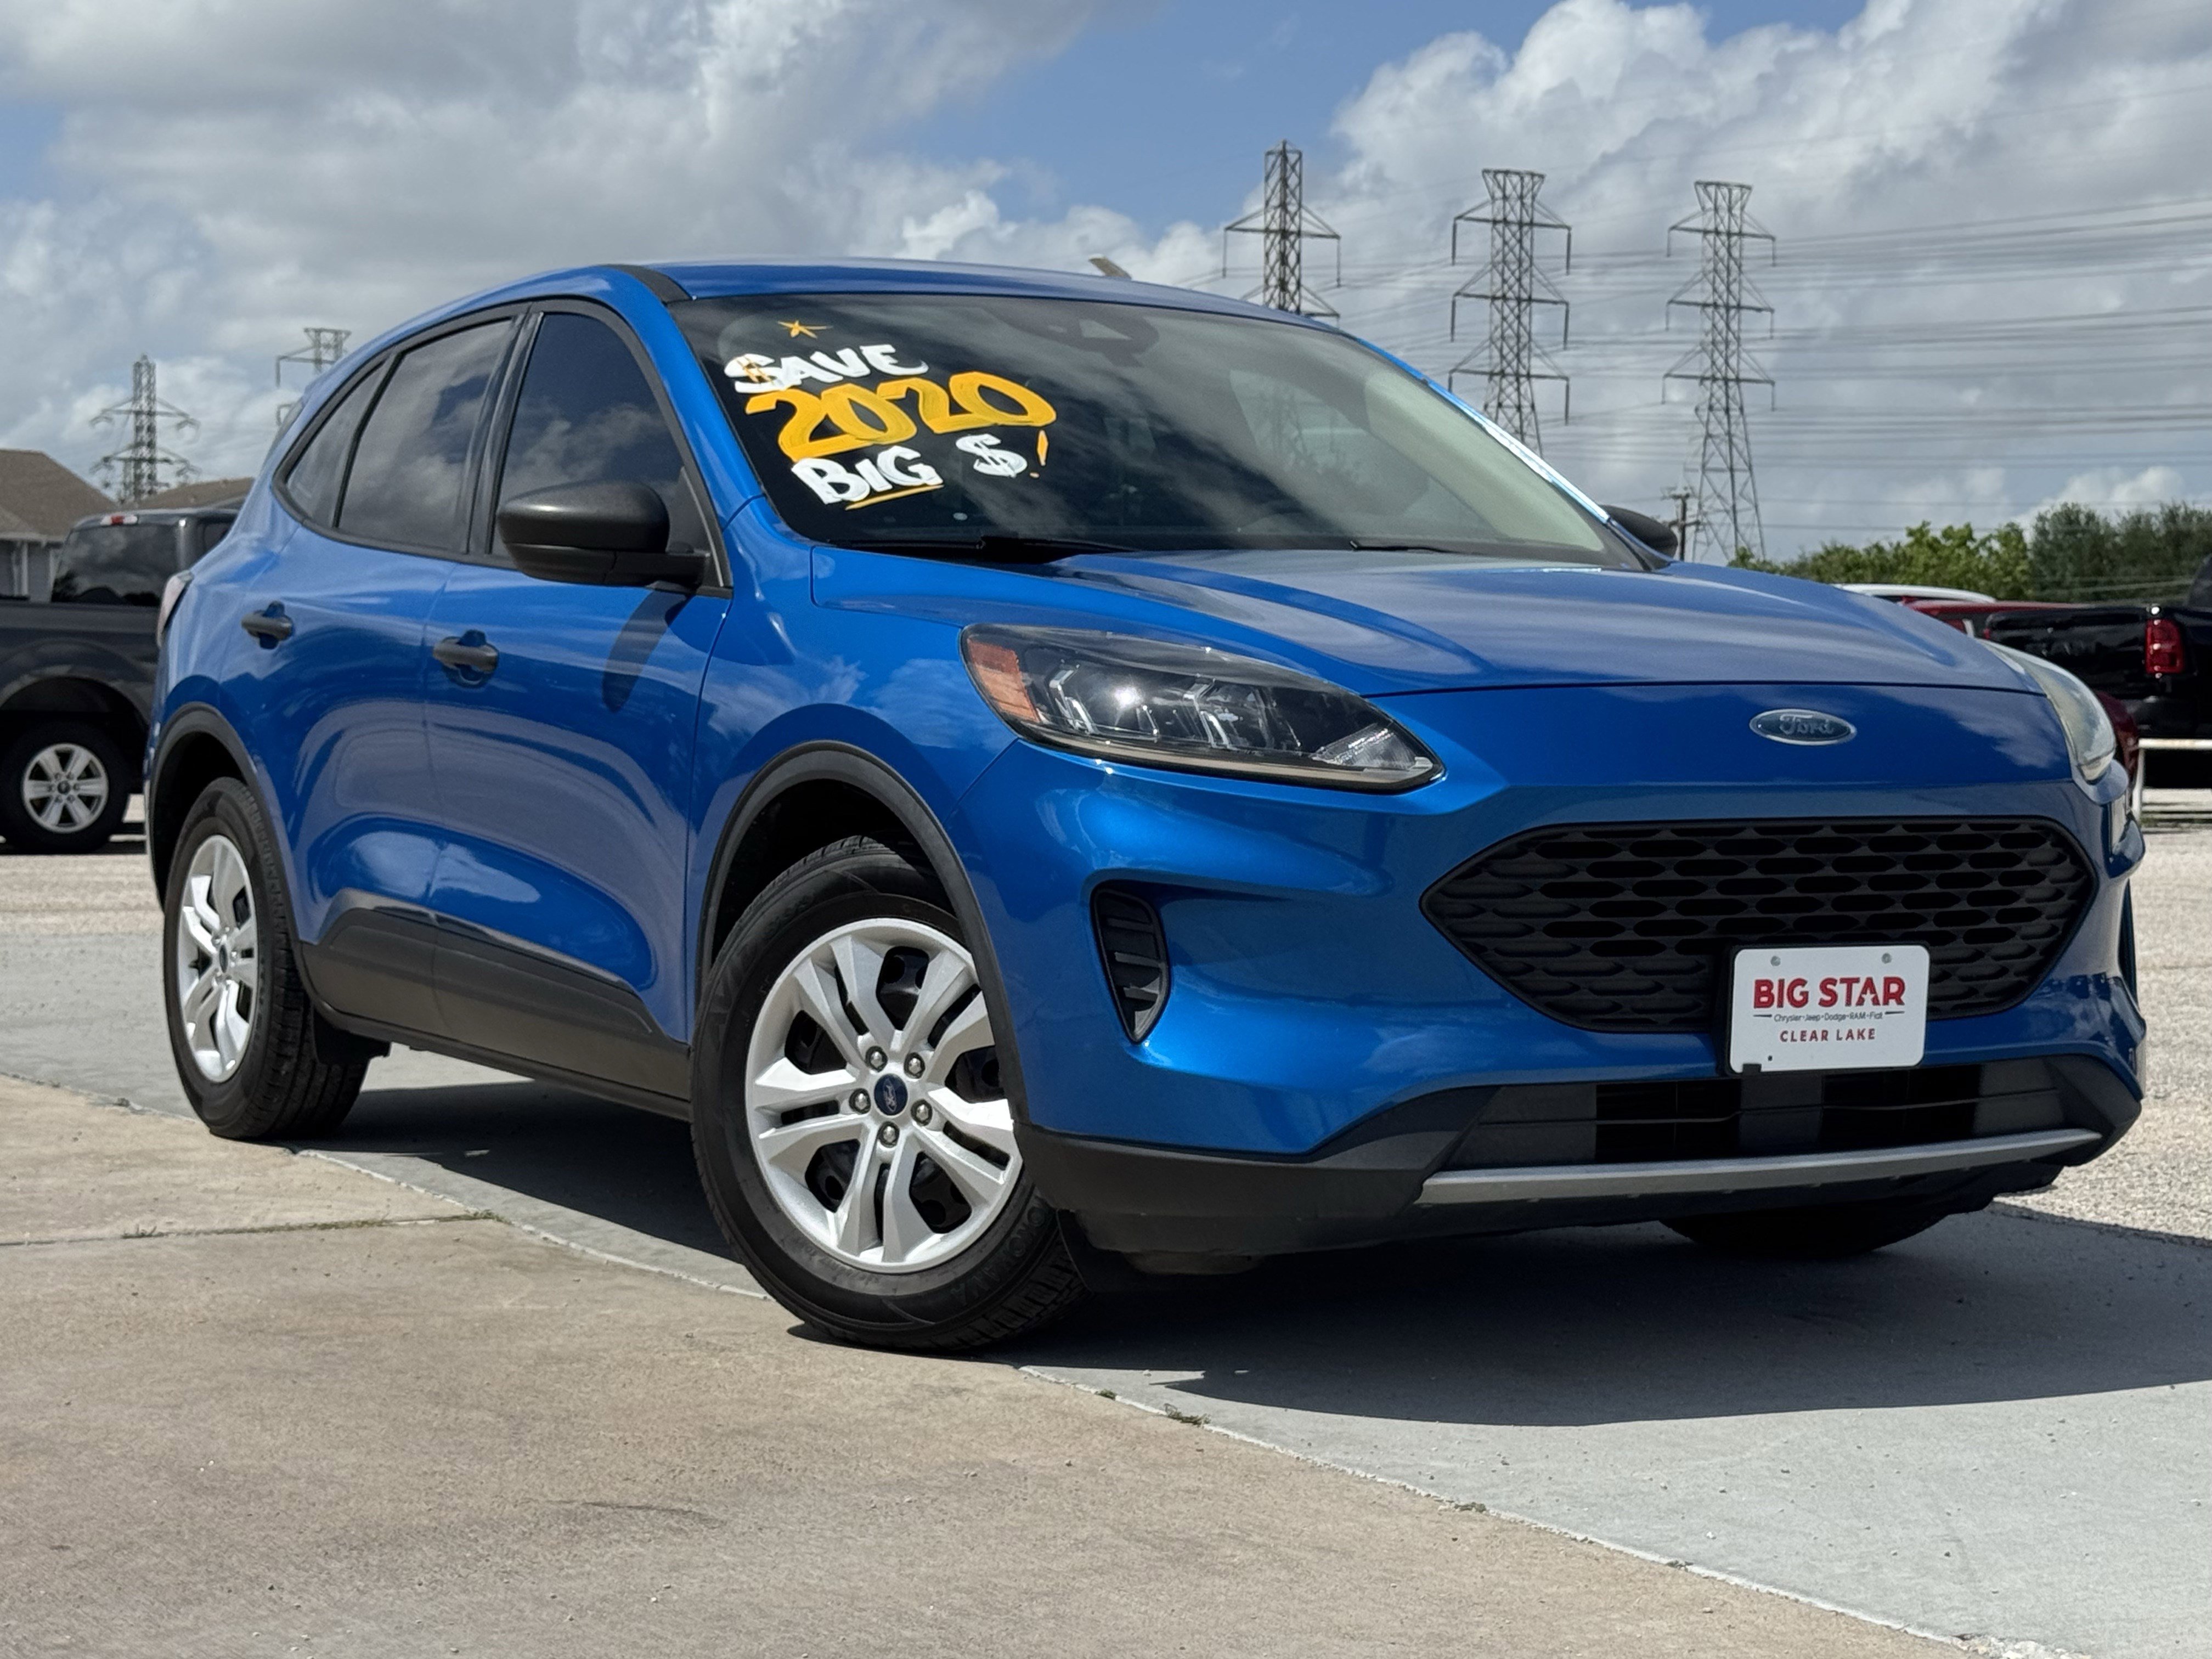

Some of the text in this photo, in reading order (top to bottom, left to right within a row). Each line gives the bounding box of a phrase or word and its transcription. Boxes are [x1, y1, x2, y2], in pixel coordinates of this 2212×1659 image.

[724, 345, 928, 393] SAVE
[746, 371, 1057, 462] 2020
[792, 445, 944, 504] BIG
[1779, 714, 1834, 735] Ford
[1753, 977, 1905, 1009] BIG STAR
[1780, 1028, 1876, 1042] CLEAR LAKE
